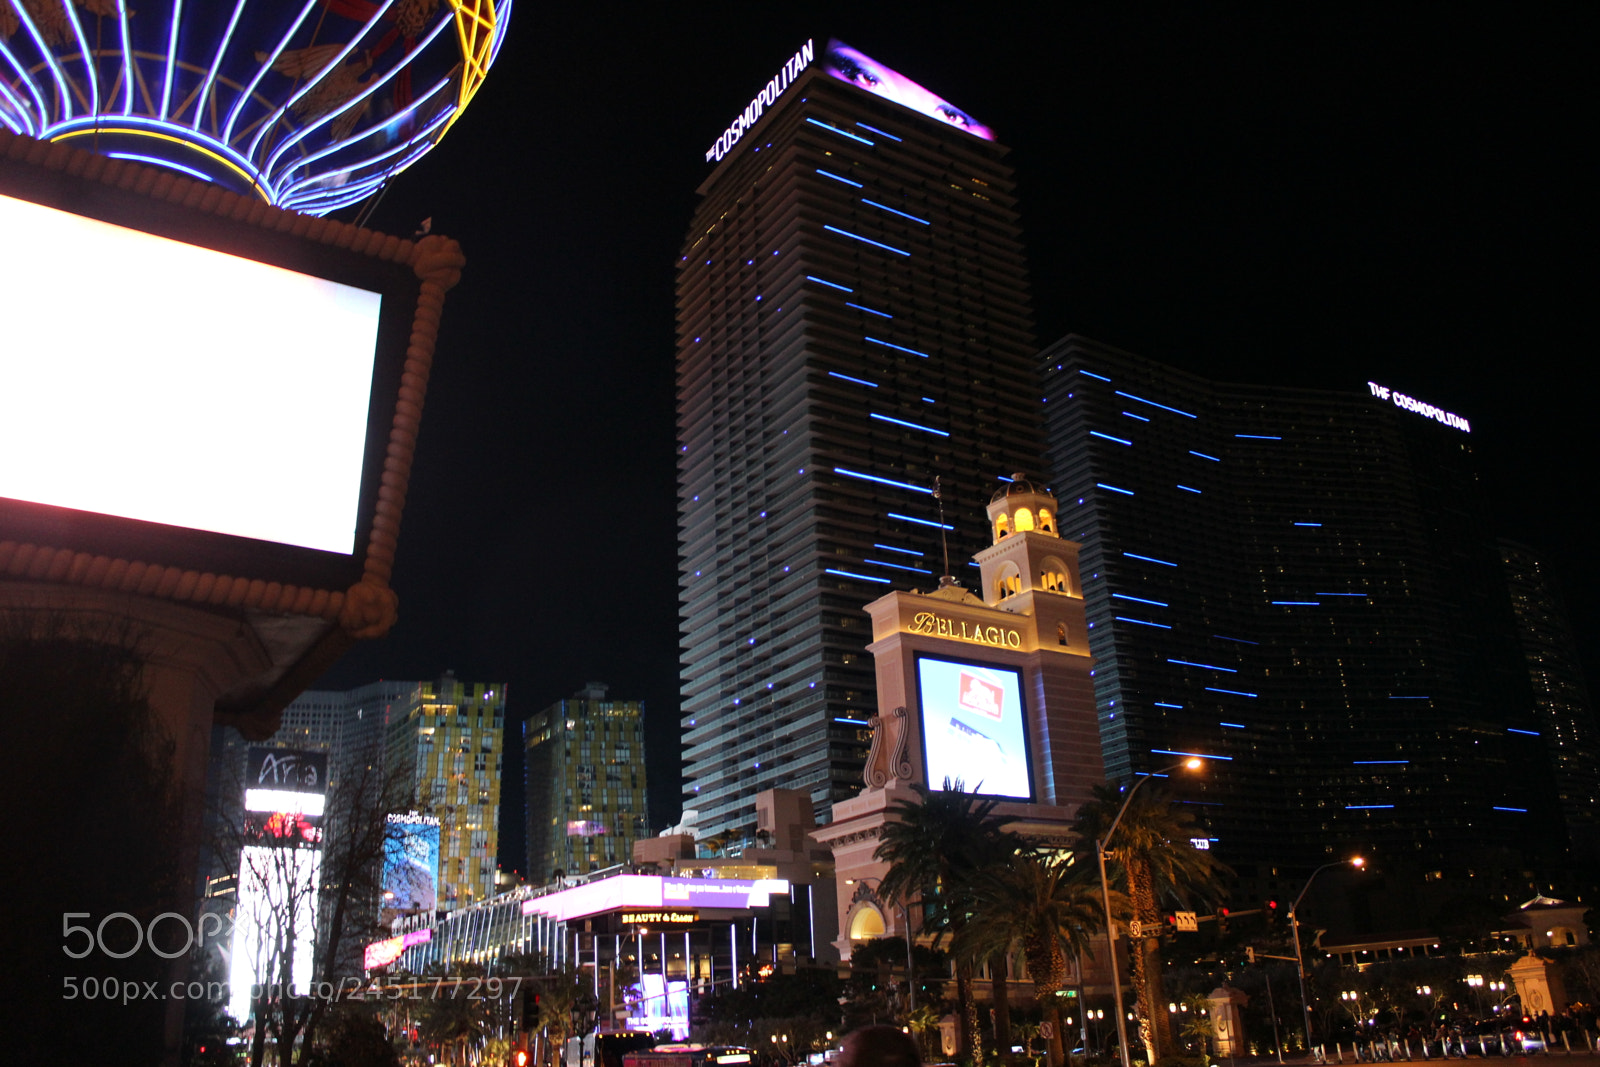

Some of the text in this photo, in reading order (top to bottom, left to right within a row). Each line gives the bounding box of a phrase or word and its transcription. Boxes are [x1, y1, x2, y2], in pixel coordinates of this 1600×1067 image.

[715, 38, 814, 161] COSMOPOLITAN
[1392, 391, 1471, 433] COSMOPOLITAN
[908, 612, 1021, 648] BELLAGIO
[622, 913, 662, 923] BEAUTY
[662, 913, 670, 922] &
